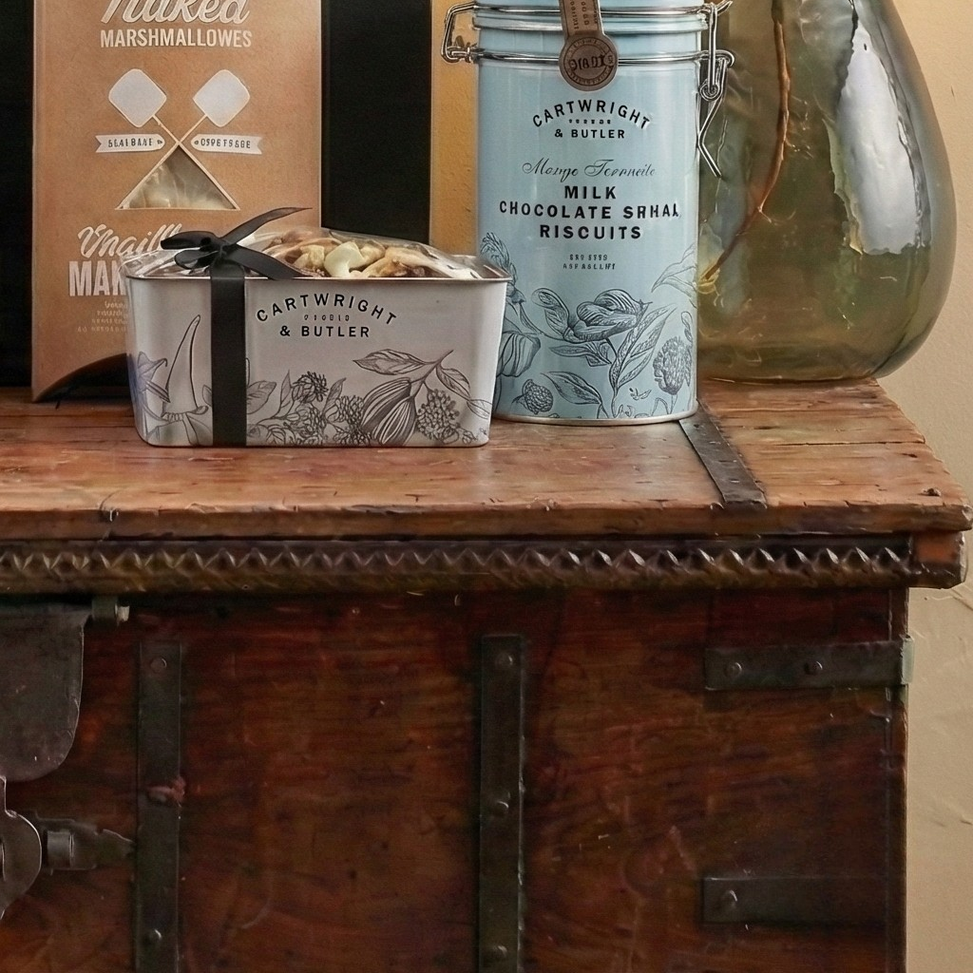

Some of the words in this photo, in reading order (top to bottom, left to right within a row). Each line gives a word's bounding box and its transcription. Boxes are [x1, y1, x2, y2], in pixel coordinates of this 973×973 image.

[100, 28, 253, 48] MARSHMALLOWES
[532, 98, 651, 130] CARTWRIGHT
[554, 128, 564, 139] &
[570, 128, 626, 140] BUTLER
[564, 185, 617, 200] MILK
[499, 200, 612, 220] CHOCOLATE
[538, 224, 642, 240] RISCUITS
[256, 292, 398, 325] CARTWRIGHT
[279, 324, 291, 338] &
[300, 325, 370, 338] BUTLER
